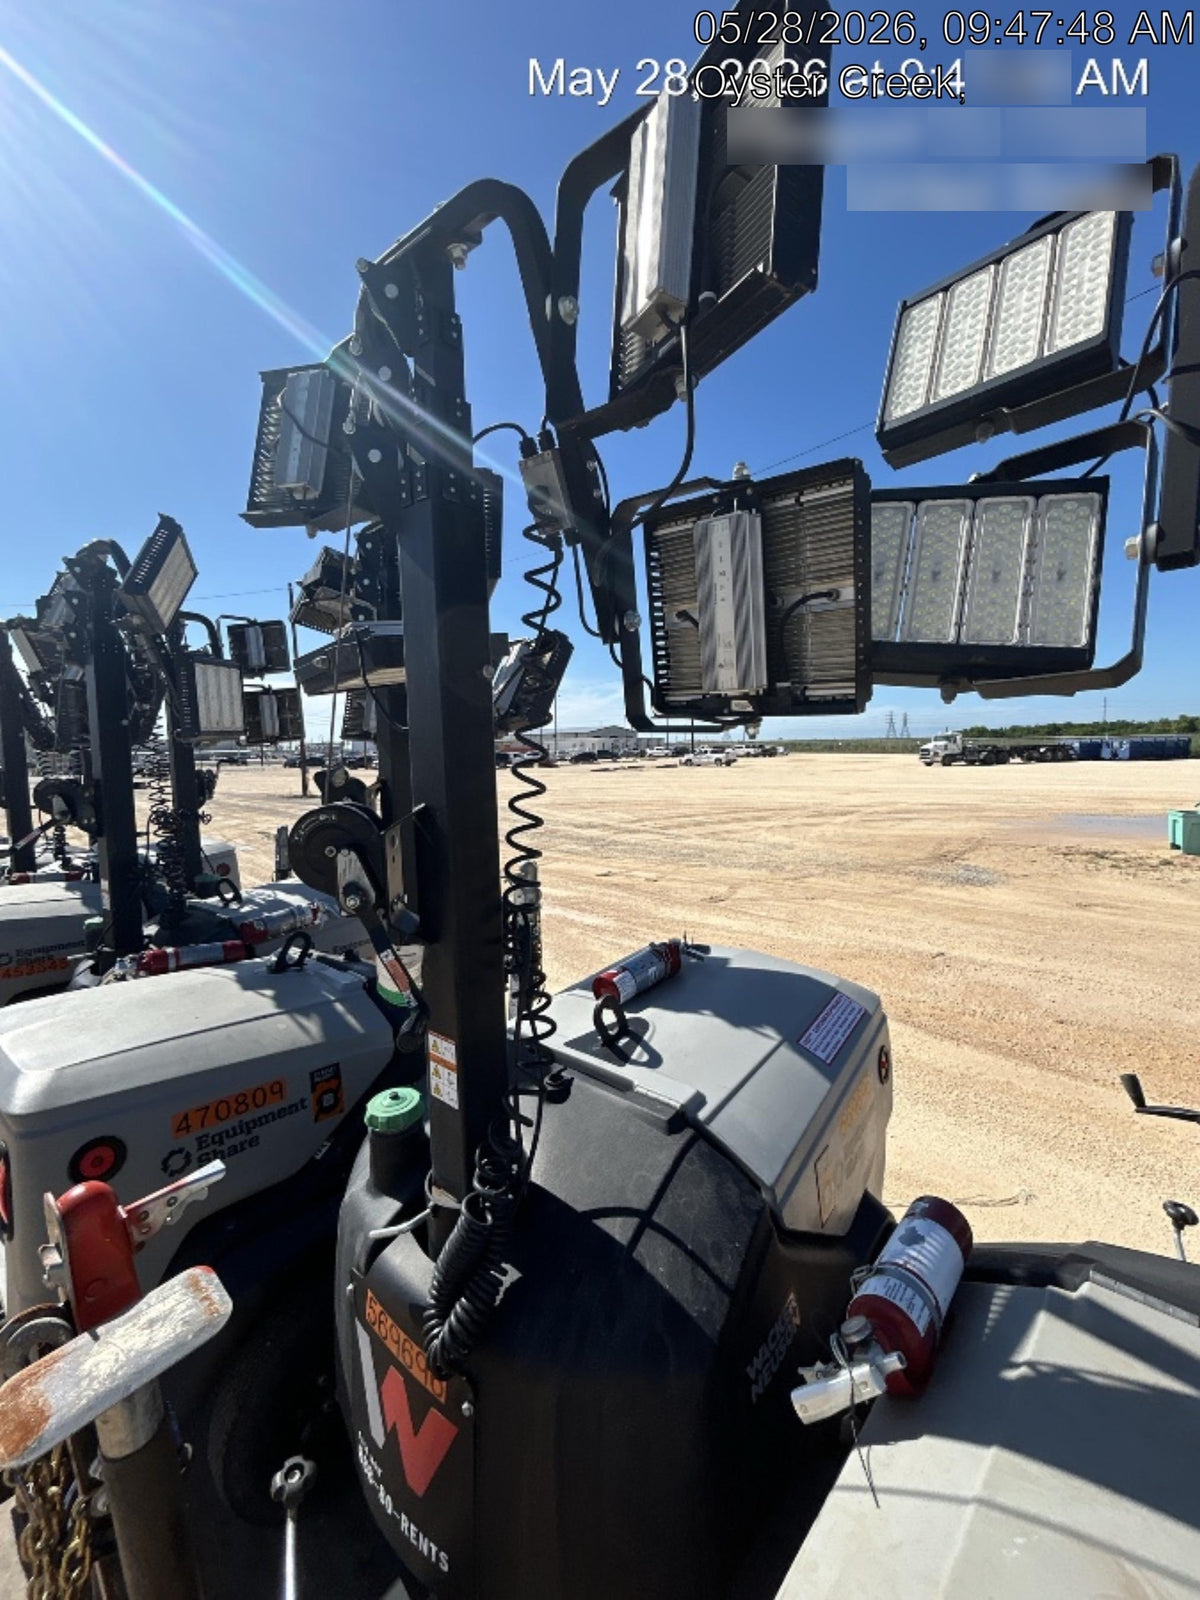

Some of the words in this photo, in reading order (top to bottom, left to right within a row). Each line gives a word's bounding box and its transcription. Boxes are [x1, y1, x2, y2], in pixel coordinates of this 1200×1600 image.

[175, 1080, 284, 1135] 470809
[195, 1097, 308, 1152] Equipment
[196, 1134, 261, 1169] Share
